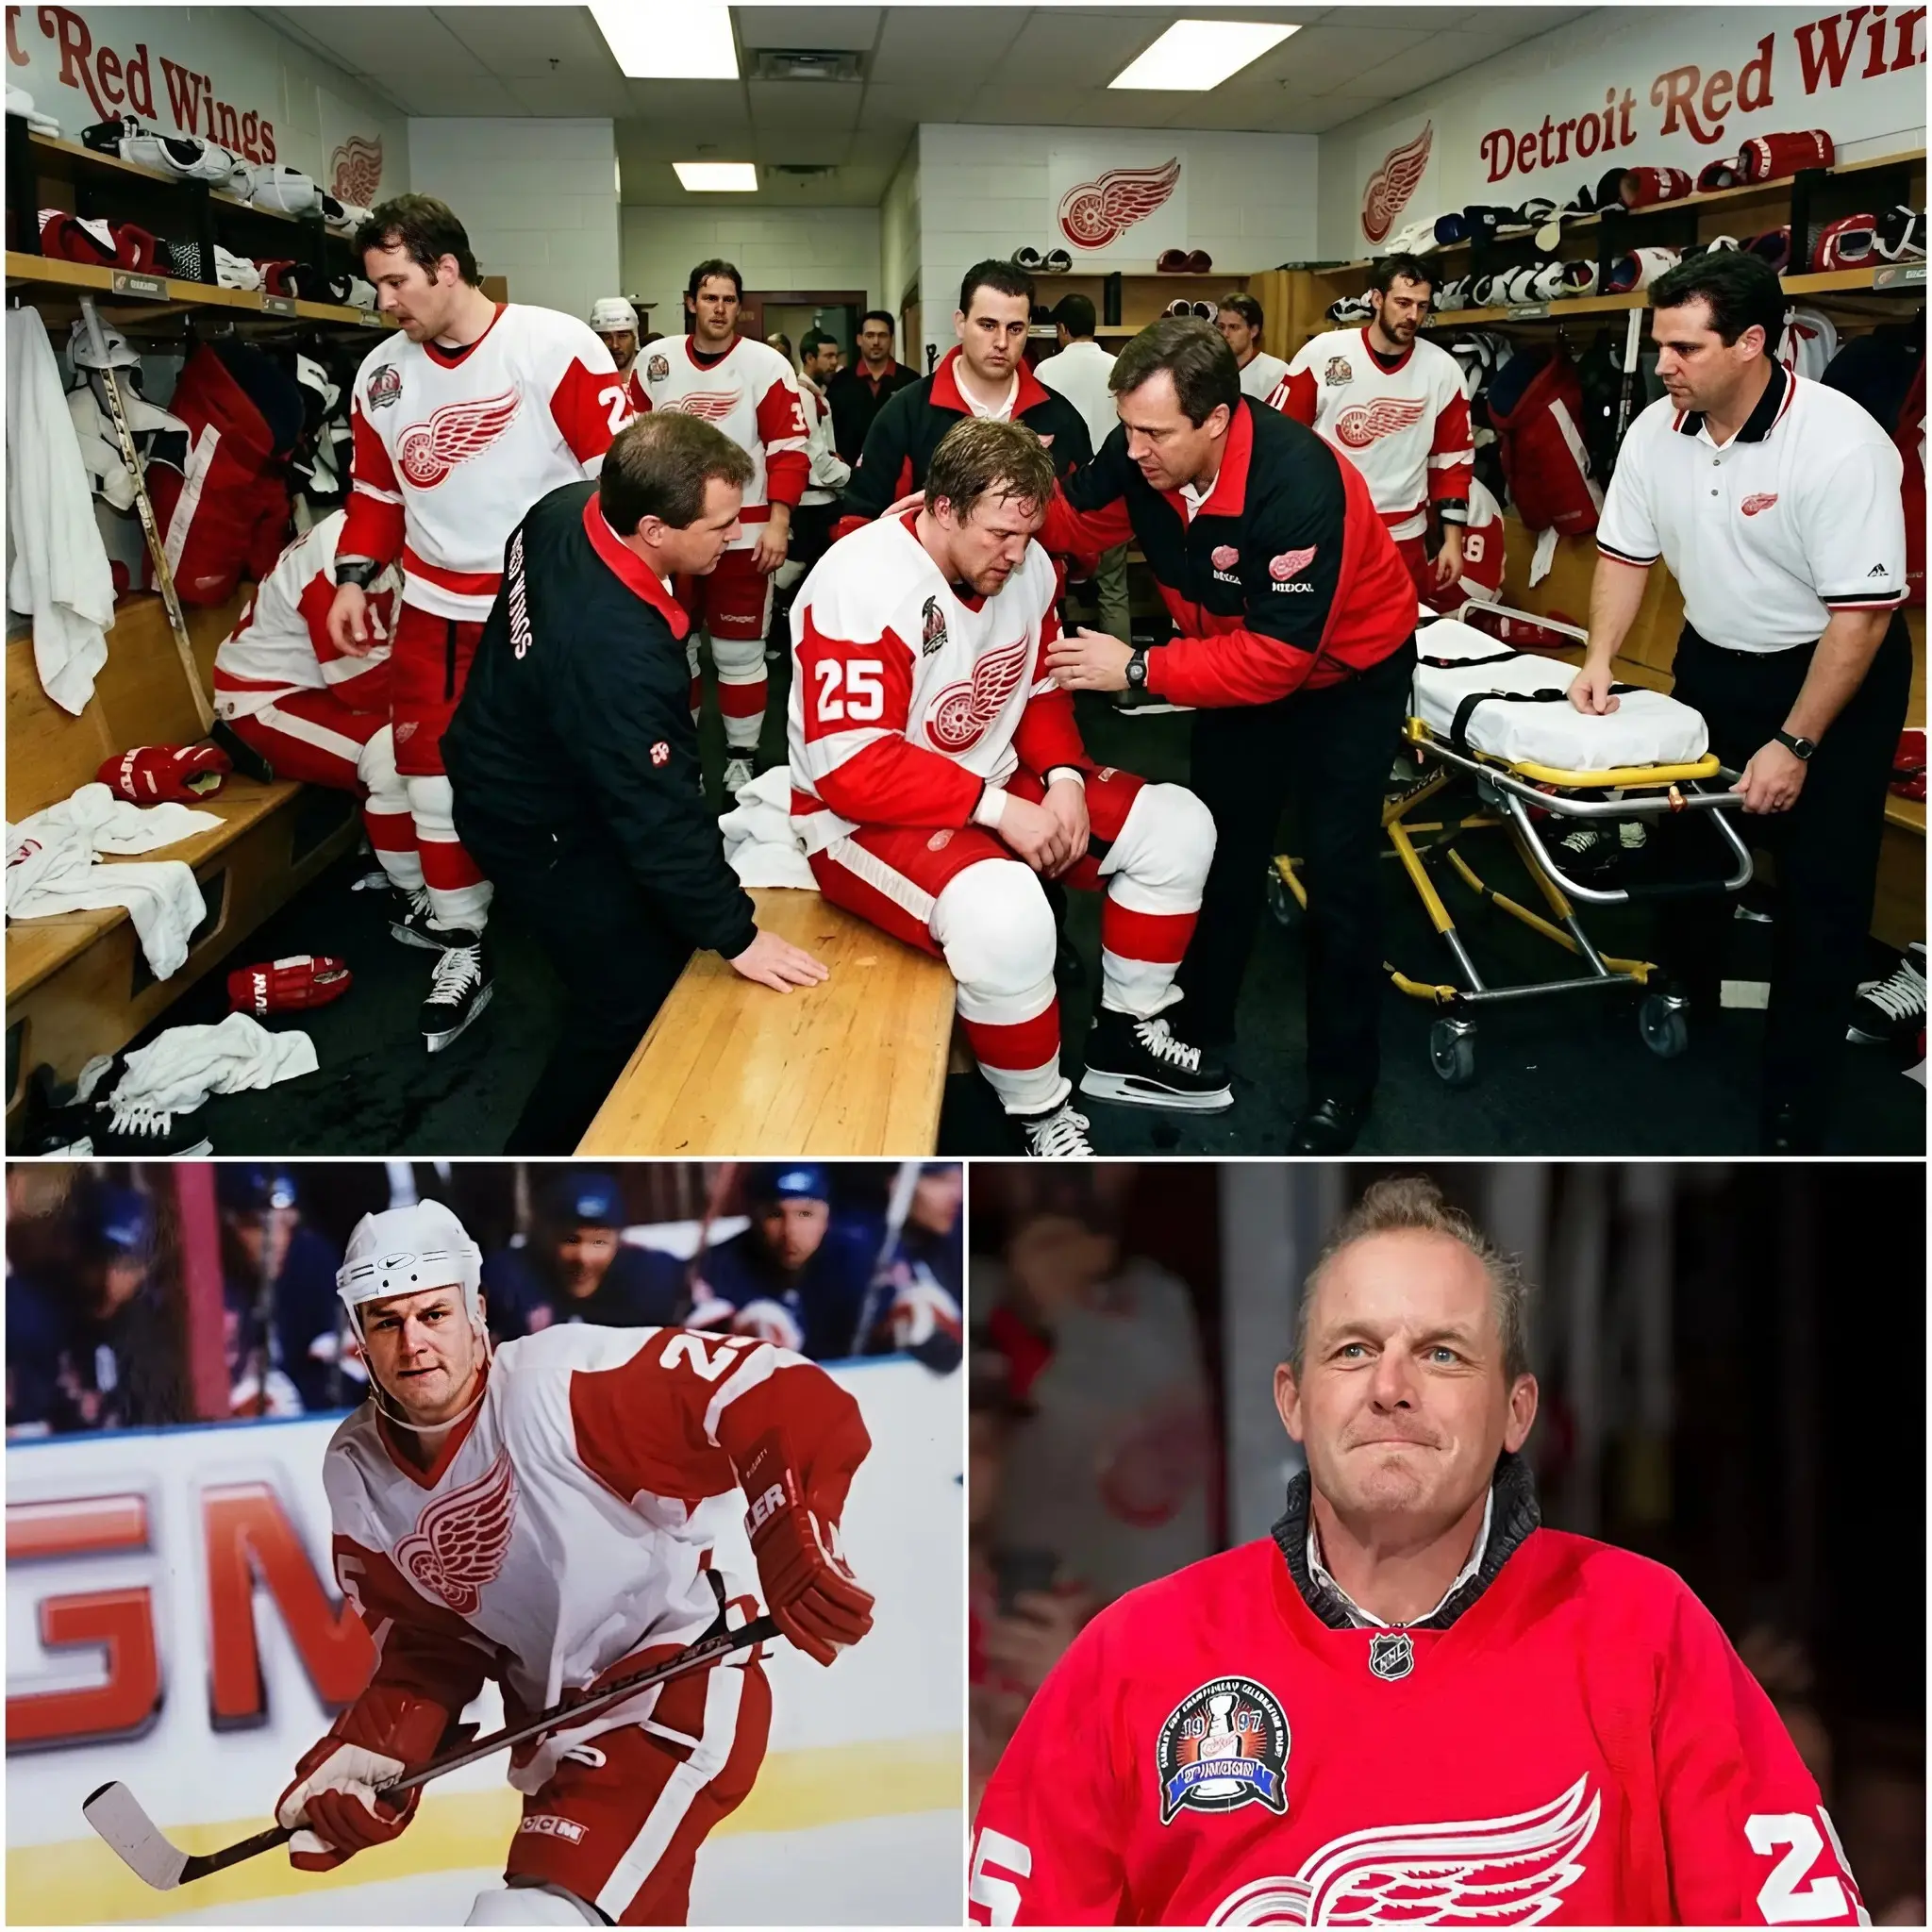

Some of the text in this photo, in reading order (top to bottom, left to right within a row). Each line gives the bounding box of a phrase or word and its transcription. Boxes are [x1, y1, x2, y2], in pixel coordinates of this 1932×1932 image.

[38, 6, 158, 122] Red
[158, 57, 276, 165] Wings
[1480, 87, 1637, 183] Detroit
[1651, 32, 1774, 144] Red
[815, 658, 883, 723] 25
